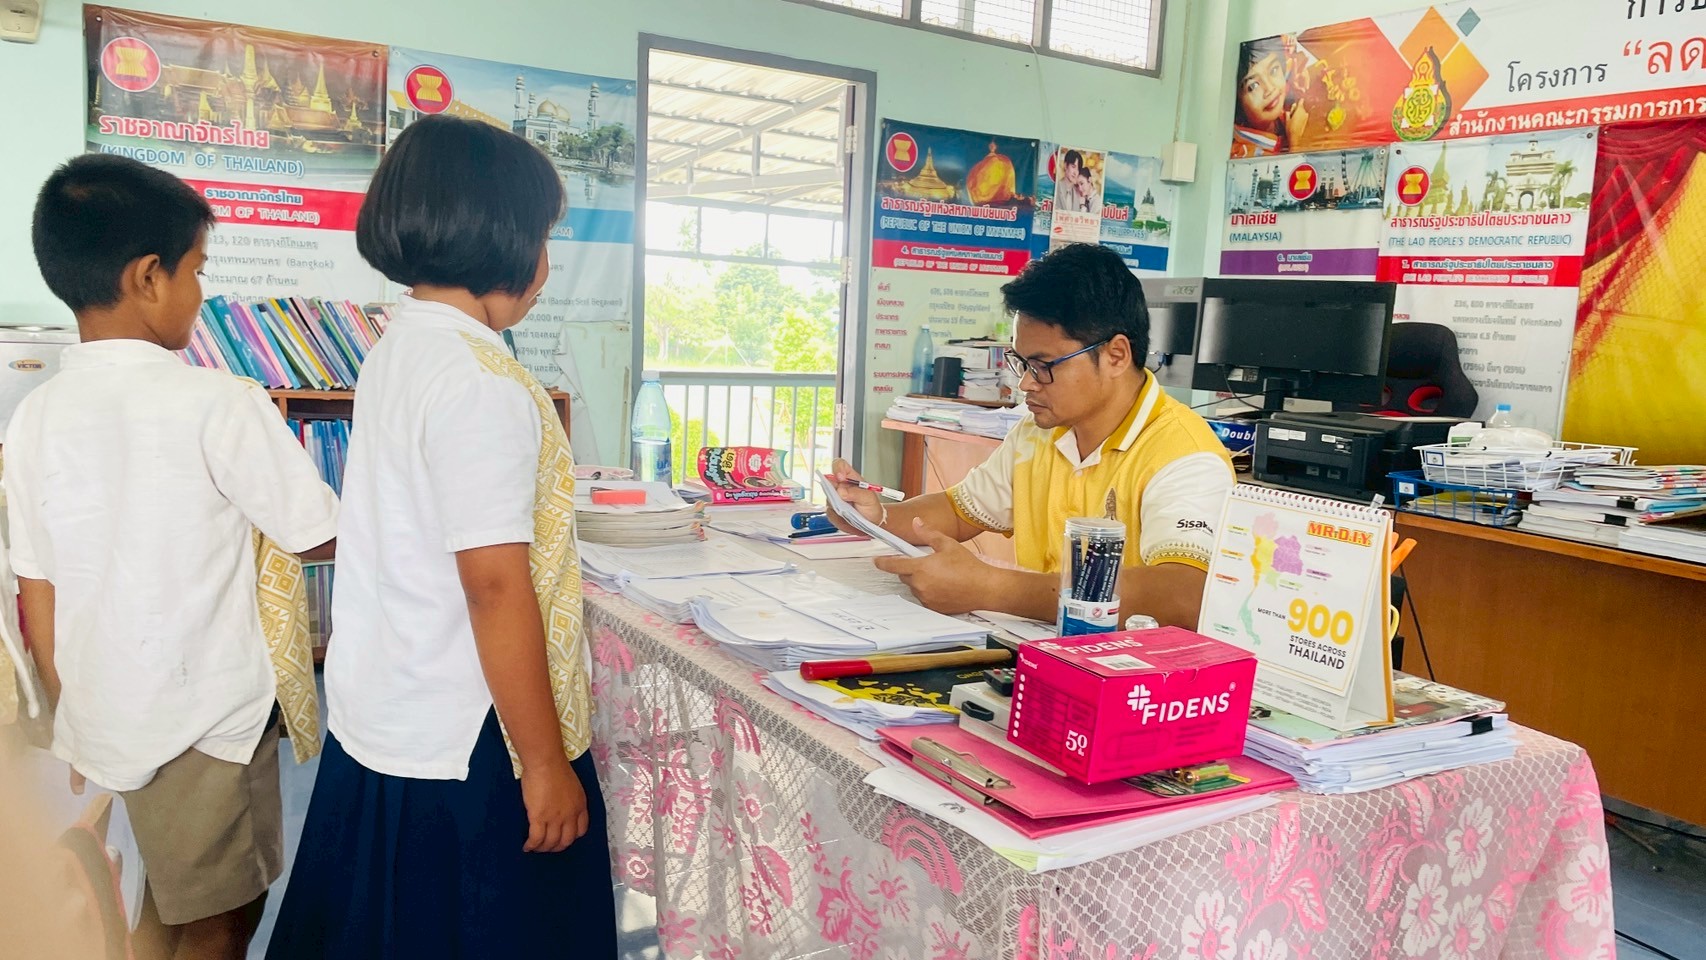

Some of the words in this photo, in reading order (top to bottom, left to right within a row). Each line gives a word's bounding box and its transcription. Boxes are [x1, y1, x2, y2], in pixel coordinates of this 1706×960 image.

[1507, 61, 1608, 93] โครงการ
[99, 115, 270, 149] ราชอาณาจักรไทย
[195, 153, 216, 167] OF
[222, 154, 304, 177] THAILAND)
[205, 188, 303, 205] ราชอาณาจักรไทย
[235, 207, 253, 218] OF
[258, 208, 320, 224] THAILAND)
[1231, 211, 1277, 225] มาเลเซีย
[1390, 211, 1571, 230] สาธารณรัฐประชาธิปไตยประชาชนลาว
[880, 216, 917, 231] (REPUBLIC
[919, 219, 930, 232] OF
[932, 220, 946, 233] THE
[948, 222, 972, 235] UNION
[974, 225, 985, 236] OF
[986, 226, 1025, 240] MYANMAR)
[1229, 232, 1282, 243] (MALAYSIA)
[1389, 237, 1404, 248] (THE
[1408, 236, 1425, 246] LAO
[1429, 236, 1464, 246] PEOPLE'S
[1468, 235, 1523, 246] DEMOCRATIC
[1527, 234, 1571, 246] REPUBLIC)
[286, 258, 334, 271] (Bangkok)
[250, 276, 263, 285] 67
[1221, 427, 1255, 441] Doubl
[1257, 608, 1271, 616] MORE
[1272, 611, 1286, 620] THAN
[1287, 598, 1354, 646] 900
[1063, 638, 1144, 655] FIDENS
[1290, 635, 1316, 649] STORES
[1317, 643, 1346, 658] ACROSS
[1289, 643, 1345, 670] THAILAND
[1141, 692, 1230, 725] FIDENS
